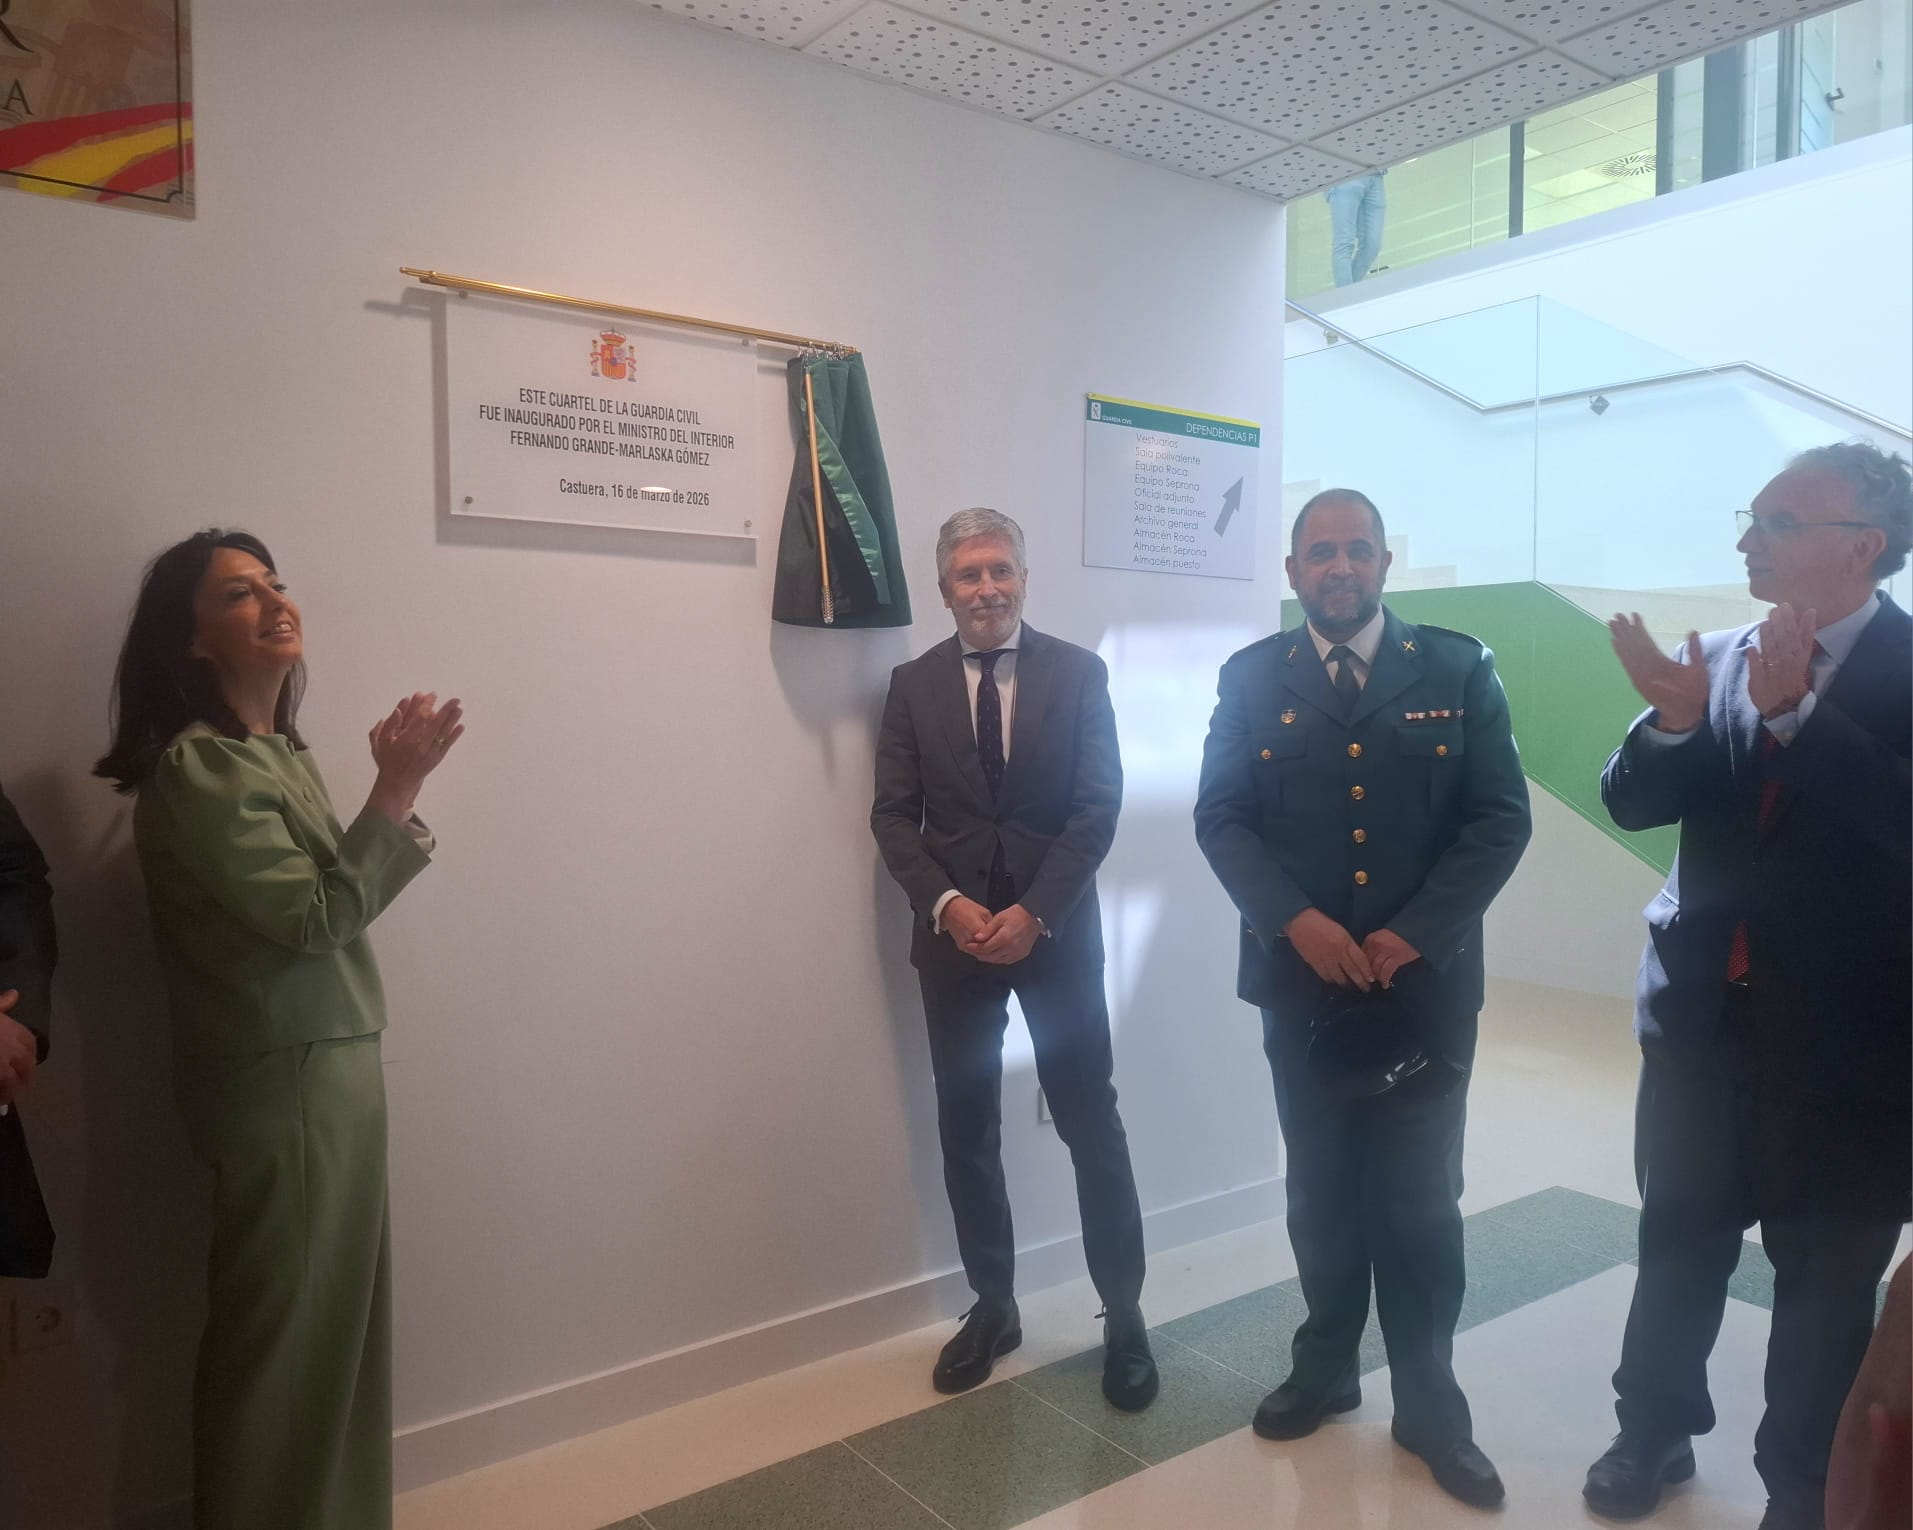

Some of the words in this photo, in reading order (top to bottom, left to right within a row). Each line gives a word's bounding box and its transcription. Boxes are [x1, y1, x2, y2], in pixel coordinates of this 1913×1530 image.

[519, 388, 546, 405] ESTE
[549, 392, 597, 412] CUARTEL
[599, 399, 613, 414] DE
[616, 401, 628, 416] LA
[630, 403, 675, 422] GUARDIA
[676, 409, 701, 425] CIVIL
[479, 405, 501, 421] FUE
[504, 408, 576, 430] INAUGURADO
[579, 417, 600, 433] POR
[603, 420, 615, 435] EL
[618, 422, 667, 441] MINISTRO
[670, 428, 688, 444] DEL
[690, 431, 735, 449] INTERIOR
[1186, 422, 1247, 442] DEPENDENCIAS
[1248, 433, 1257, 444] P1
[510, 430, 569, 451] FERNANDO
[572, 438, 674, 462] GRANDE-MARLASKA
[675, 447, 710, 466] GÓMEZ
[1135, 432, 1178, 449] Vestuarios
[1135, 446, 1154, 459] Sala
[1156, 450, 1201, 466] polivalente
[1135, 460, 1164, 474] Equipo
[1166, 465, 1188, 477] Roca
[559, 478, 608, 498] Castuera,
[611, 484, 624, 498] 16
[626, 485, 638, 499] de
[673, 489, 684, 504] de
[686, 491, 710, 506] 2026
[1135, 473, 1164, 488] Equipo
[1165, 477, 1200, 492] Seprona
[1134, 487, 1161, 500] Oficial
[1163, 491, 1195, 504] adjunto
[1134, 500, 1152, 512] Sala
[1154, 503, 1166, 513] de
[1167, 506, 1207, 519] reuniones
[1134, 514, 1166, 527] Archivo
[1167, 519, 1199, 530] general
[1133, 527, 1172, 541] Almacén
[1173, 531, 1195, 543] Roca
[1133, 541, 1171, 553] Almacén
[1173, 545, 1207, 558] Seprona
[1172, 559, 1201, 570] puesto
